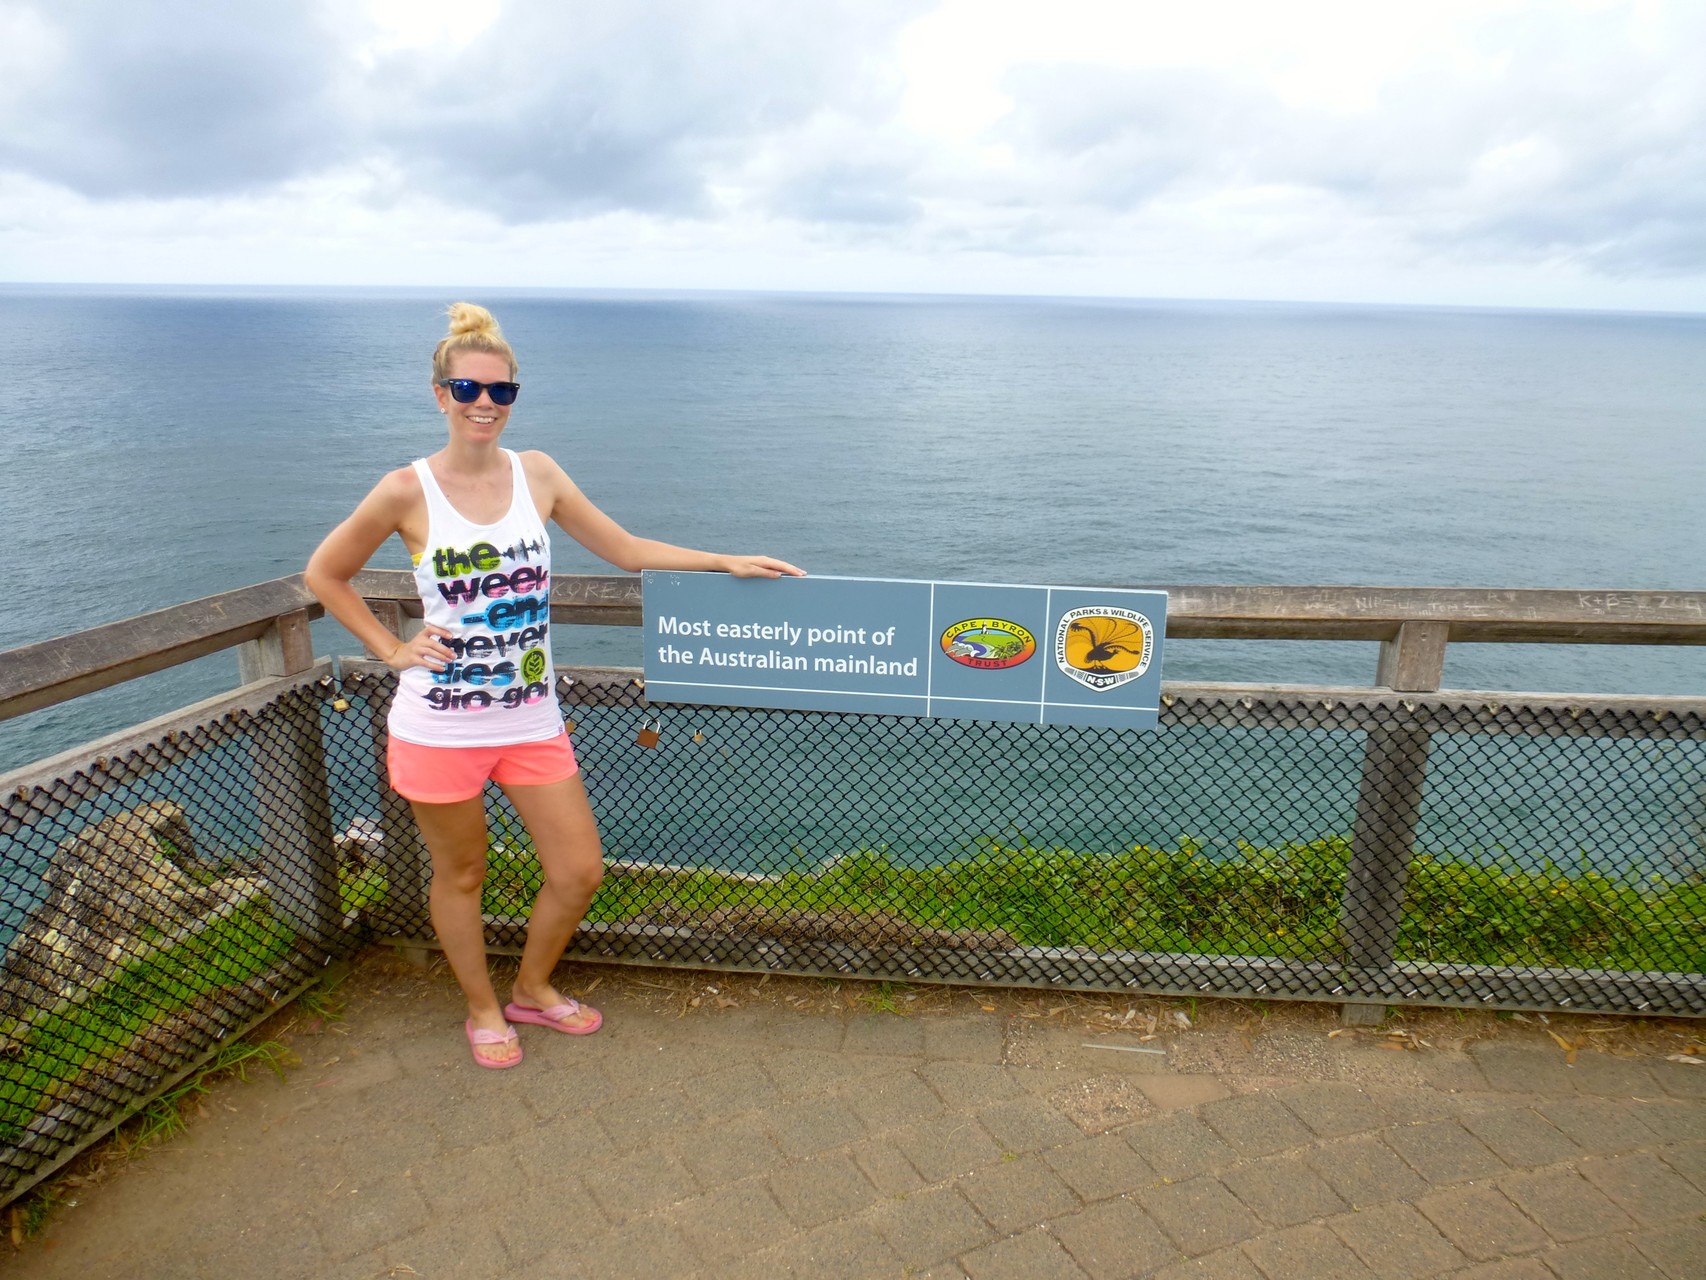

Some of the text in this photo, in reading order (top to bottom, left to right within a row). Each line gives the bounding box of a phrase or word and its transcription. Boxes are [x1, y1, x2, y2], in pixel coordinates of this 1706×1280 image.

[432, 542, 502, 578] the
[658, 616, 896, 646] Most easterly point of
[946, 621, 1032, 644] CAPE BYRON
[1058, 617, 1071, 663] NATIONAL
[1070, 608, 1102, 619] PARKS
[1110, 609, 1149, 629] WILDLIFE
[1139, 629, 1152, 668] SERVICE
[658, 645, 918, 677] the Australian mainland
[967, 658, 1008, 668] TRUST
